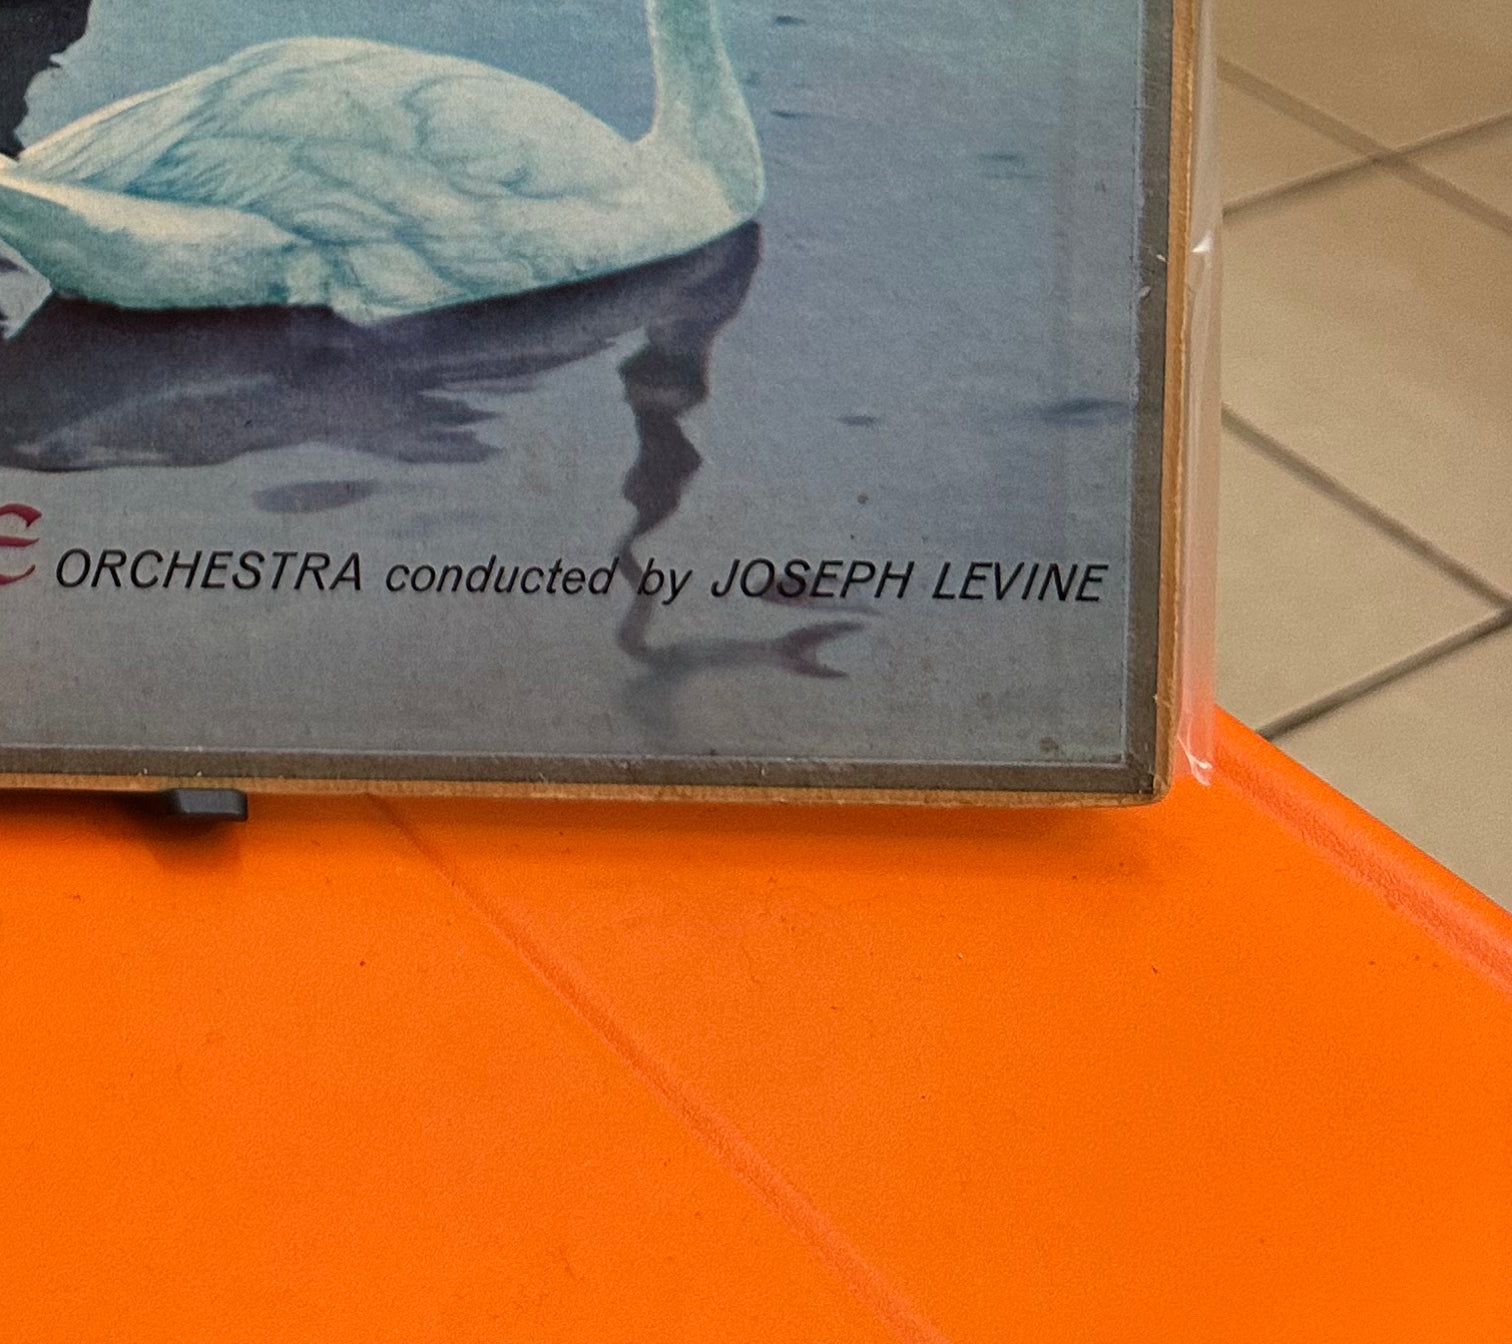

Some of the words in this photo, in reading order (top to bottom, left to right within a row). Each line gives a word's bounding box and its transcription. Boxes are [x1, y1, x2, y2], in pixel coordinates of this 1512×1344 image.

[55, 548, 363, 591] ORCHESTRA
[386, 555, 620, 596] conducted
[637, 557, 693, 606] by
[710, 557, 915, 601] JOSEPH
[932, 560, 1109, 603] LEVINE
